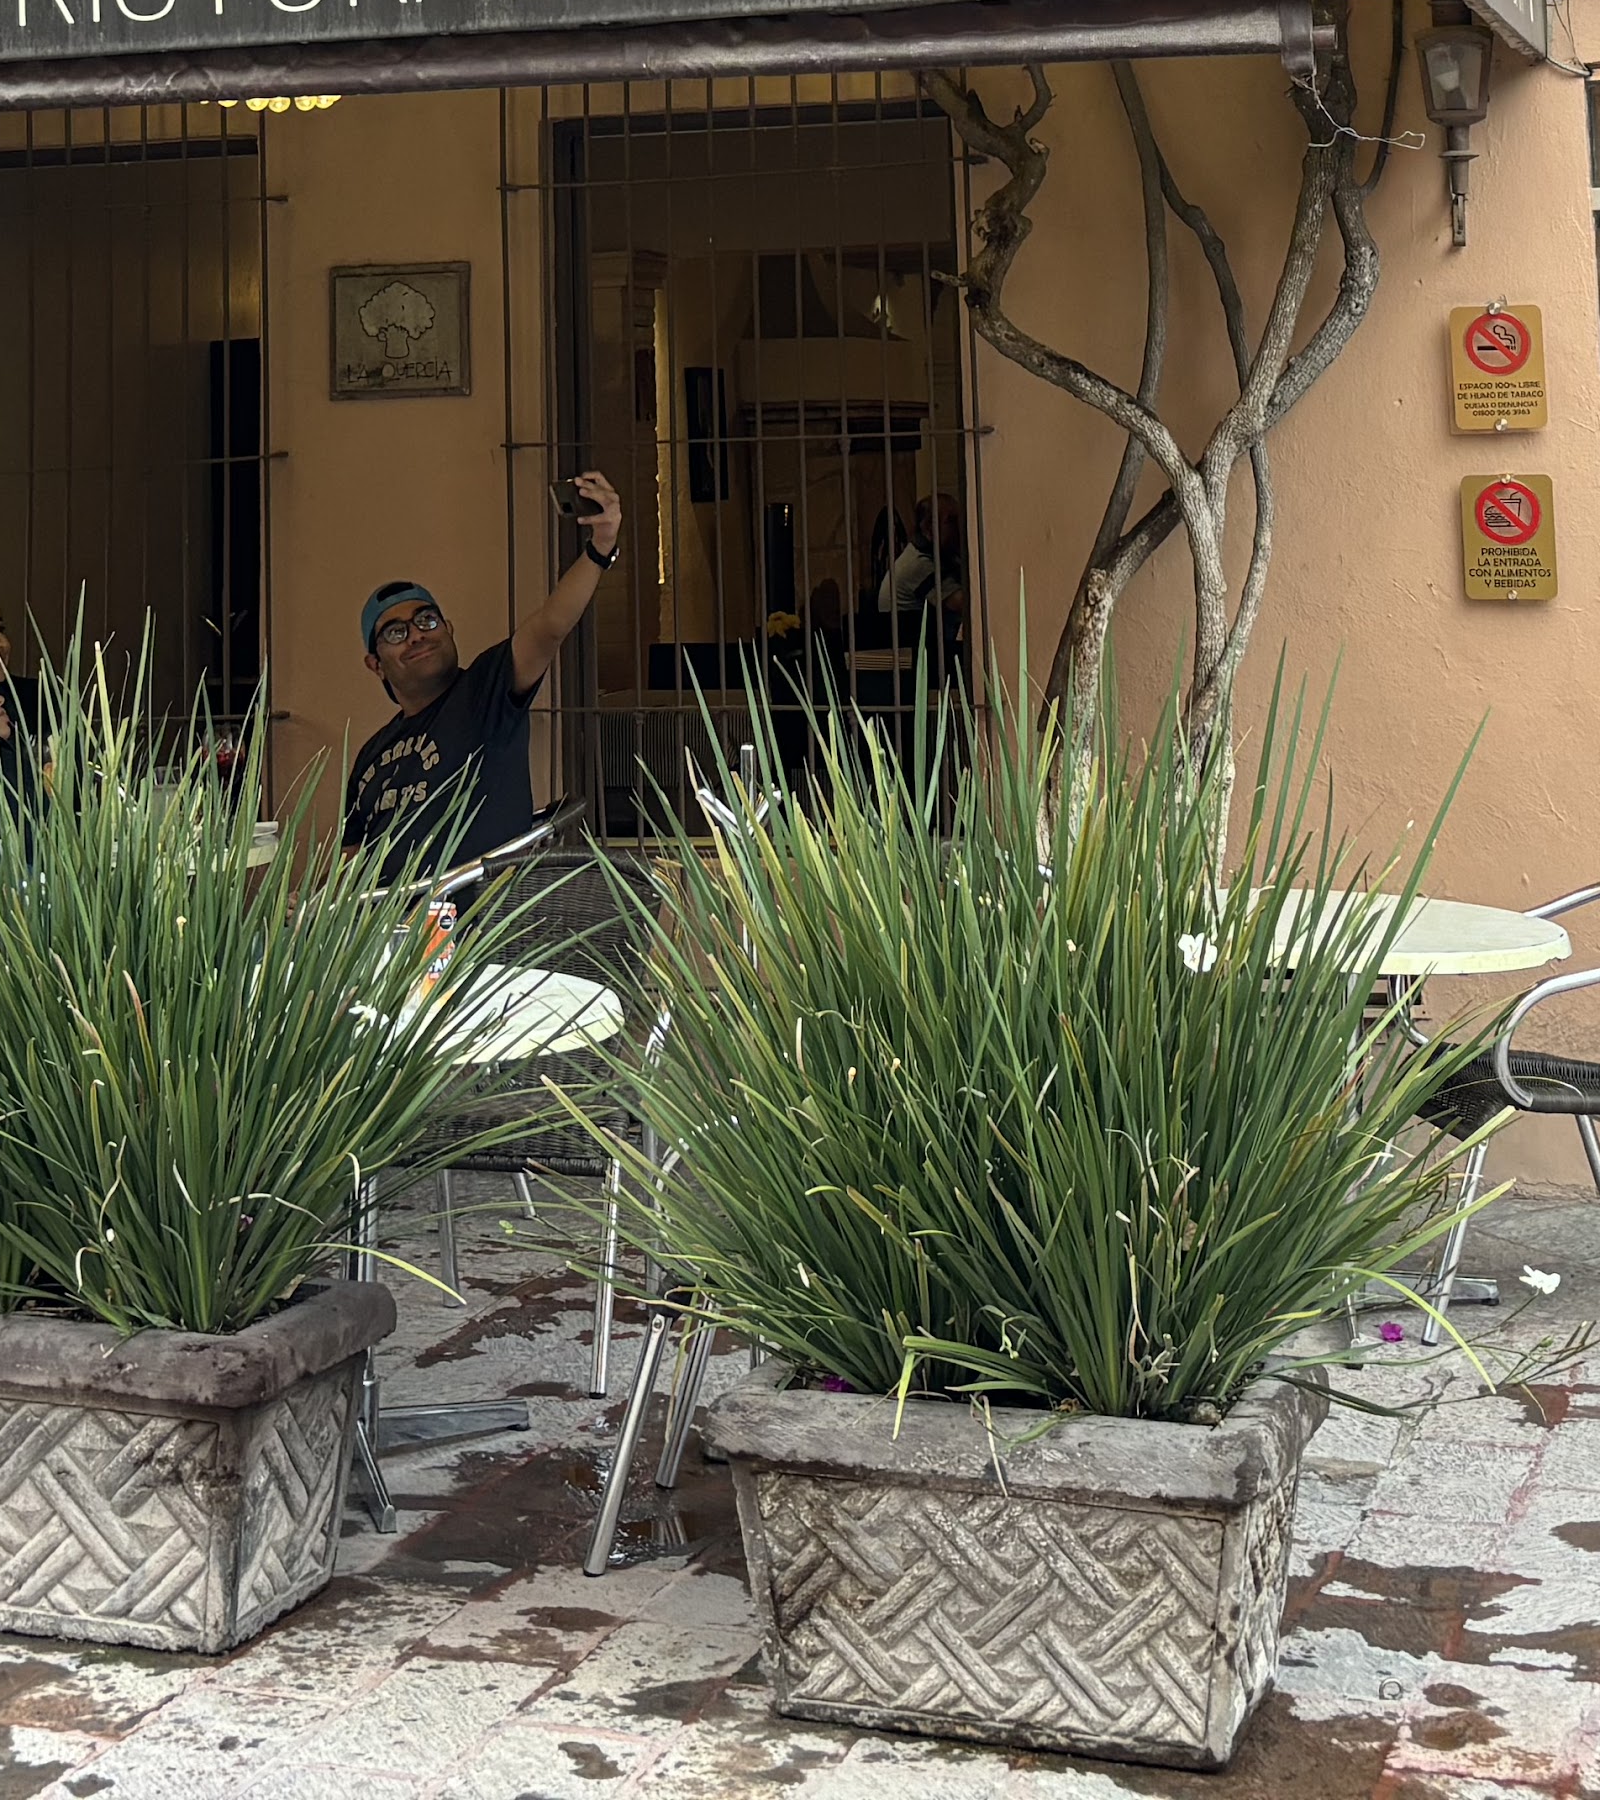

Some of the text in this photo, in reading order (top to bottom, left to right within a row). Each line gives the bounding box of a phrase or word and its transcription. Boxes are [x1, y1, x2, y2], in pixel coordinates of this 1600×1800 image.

[1459, 382, 1493, 390] ESPACIO
[1518, 381, 1541, 389] LIBRE
[1511, 390, 1544, 398] TABACO
[1497, 400, 1538, 408] DENUNCIAS
[1481, 547, 1538, 556] PROHIBIDA
[1477, 558, 1542, 567] LA ENTRADA
[1468, 568, 1552, 577] CON ALIMENTOS
[1484, 579, 1536, 588] Y BEBIDAS
